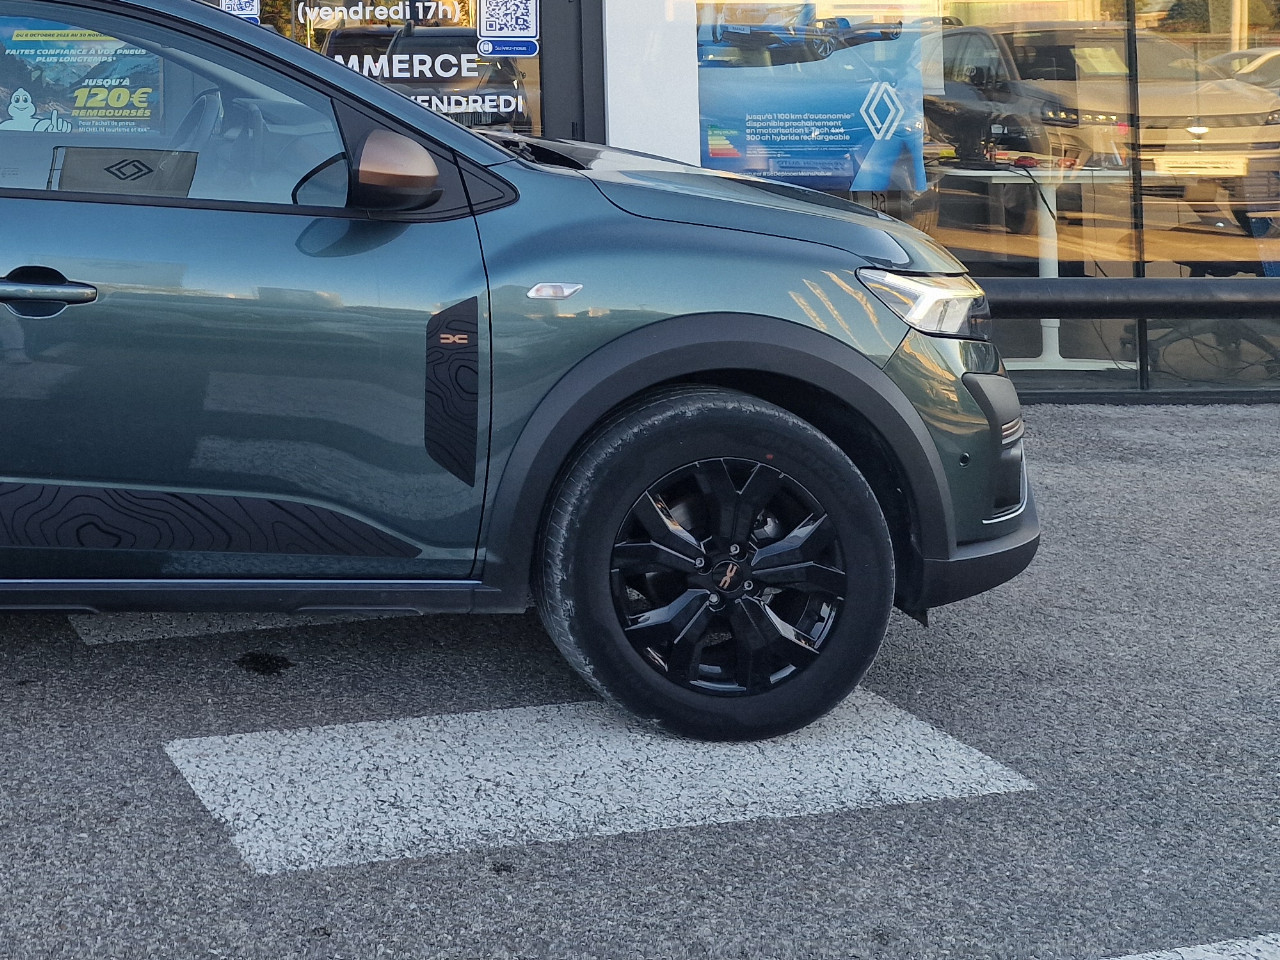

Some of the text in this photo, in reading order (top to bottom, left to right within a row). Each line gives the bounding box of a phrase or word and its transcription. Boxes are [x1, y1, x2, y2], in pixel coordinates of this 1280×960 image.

[297, 1, 461, 24] (vendredi 17h)
[333, 53, 480, 78] MMERCE
[81, 78, 130, 87] JUSQU'À
[72, 87, 153, 108] 120€
[410, 95, 524, 112] ENDREDI
[71, 107, 151, 117] REMBOURSÉS
[771, 134, 800, 142] hybride
[800, 134, 851, 142] rechargeable
